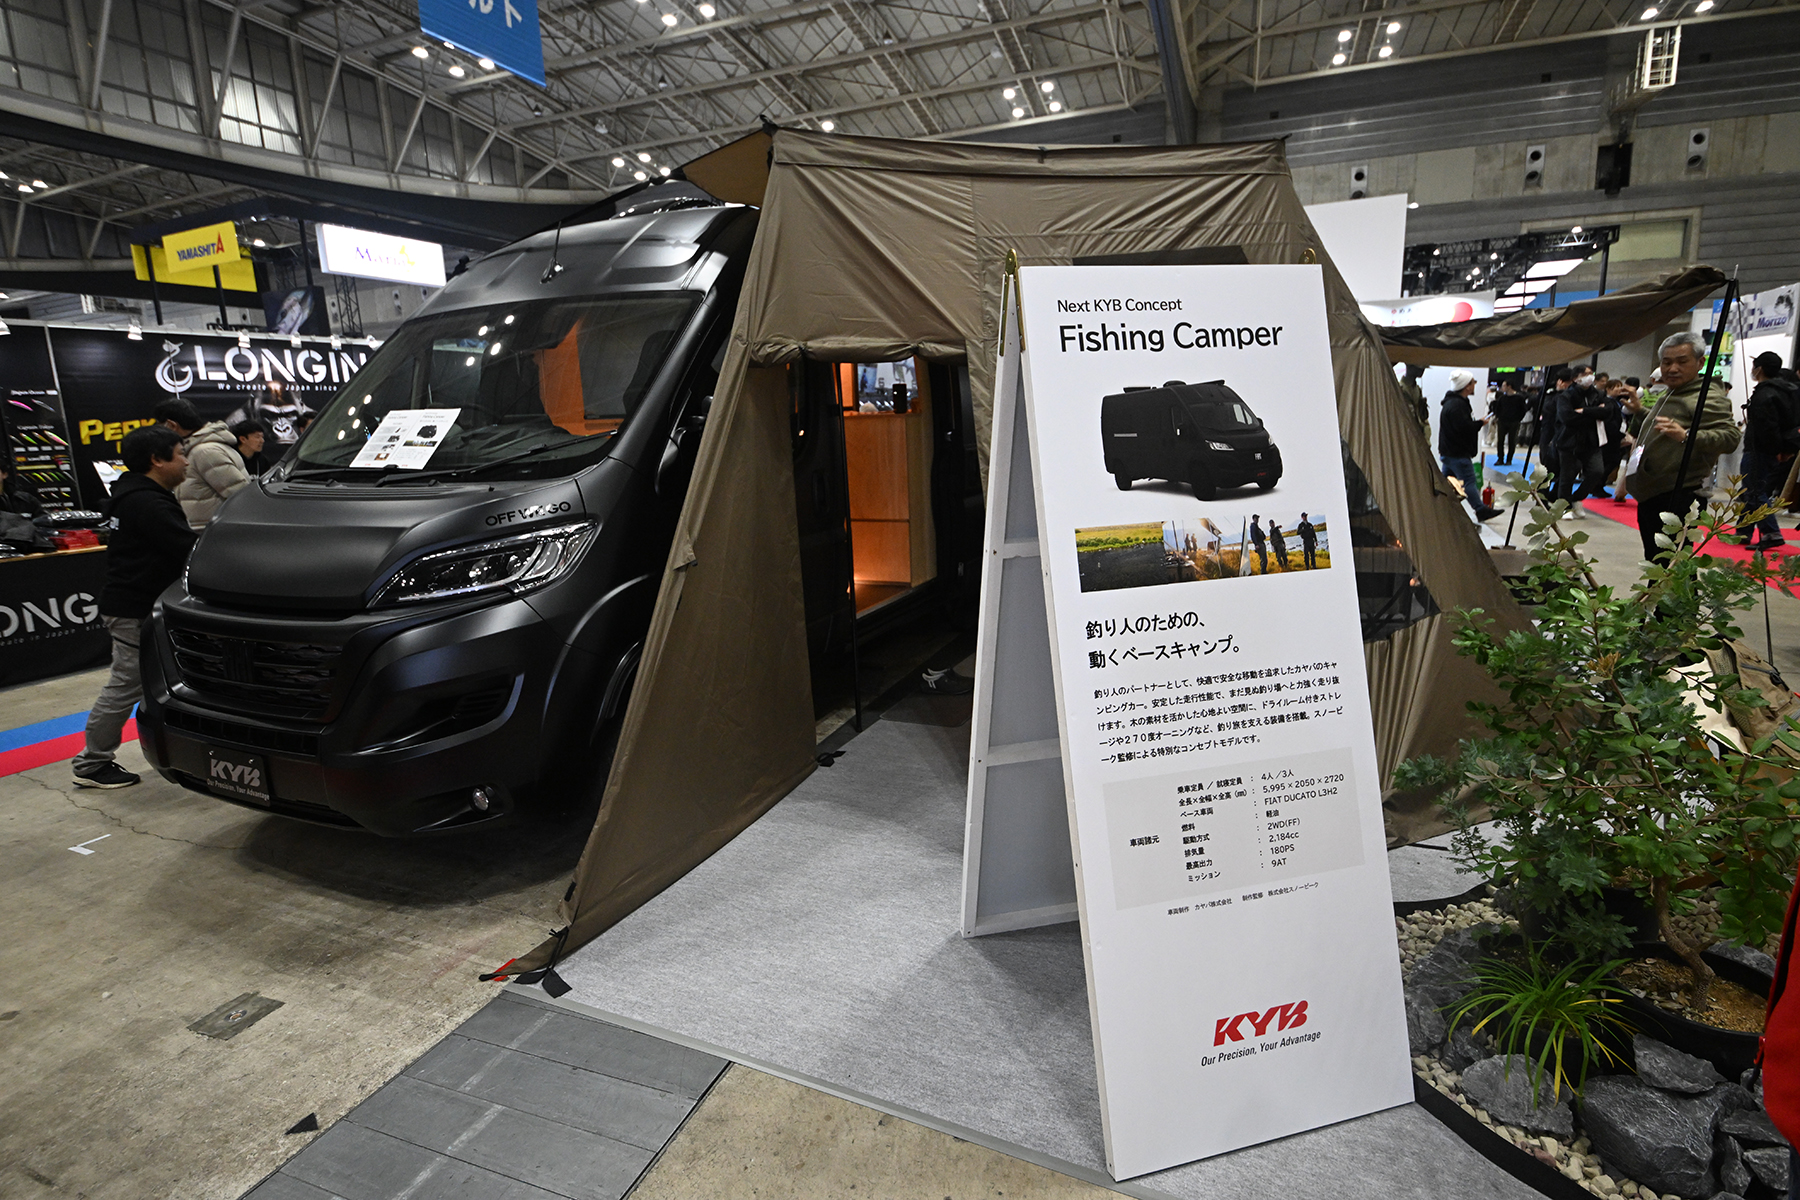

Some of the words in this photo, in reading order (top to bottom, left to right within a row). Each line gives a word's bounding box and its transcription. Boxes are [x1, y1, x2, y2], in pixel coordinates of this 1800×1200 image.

[177, 232, 225, 261] YAMASHITA
[1057, 299, 1090, 313] Next
[1094, 298, 1122, 312] KYB
[1125, 298, 1183, 312] Concept
[1059, 322, 1165, 353] Fishing
[1173, 321, 1283, 350] Camper
[194, 345, 367, 383] LONGIN
[217, 382, 231, 391] We
[236, 382, 267, 391] create
[285, 383, 311, 392] Japan
[315, 384, 338, 392] since
[485, 510, 516, 527] OFF
[546, 501, 571, 515] GO
[1085, 611, 1206, 641] 釣り人のための、
[1088, 634, 1240, 669] 動くベースキャンプ。
[1101, 734, 1261, 763] ーク監修による特別なコンセプトモデルです。
[211, 758, 260, 787] KYB
[1295, 778, 1315, 788] 2050
[1324, 774, 1344, 784] 2720
[247, 788, 269, 801] Advantage
[1180, 807, 1214, 818] ベース車両
[1264, 796, 1282, 806] FIAT
[1284, 790, 1317, 803] DUCATO
[1318, 787, 1338, 797] L3H2
[1267, 818, 1301, 831] 2WD(FF)
[1186, 859, 1213, 871] 最高出力
[1270, 844, 1295, 855] 180PS
[1188, 870, 1221, 882] ミッション
[1271, 857, 1287, 868] 9AT
[1213, 999, 1309, 1047] KYB
[1201, 1056, 1216, 1067] Our
[1218, 1047, 1257, 1063] Precision,
[1260, 1042, 1278, 1053] Your
[1280, 1031, 1322, 1048] Advantage
